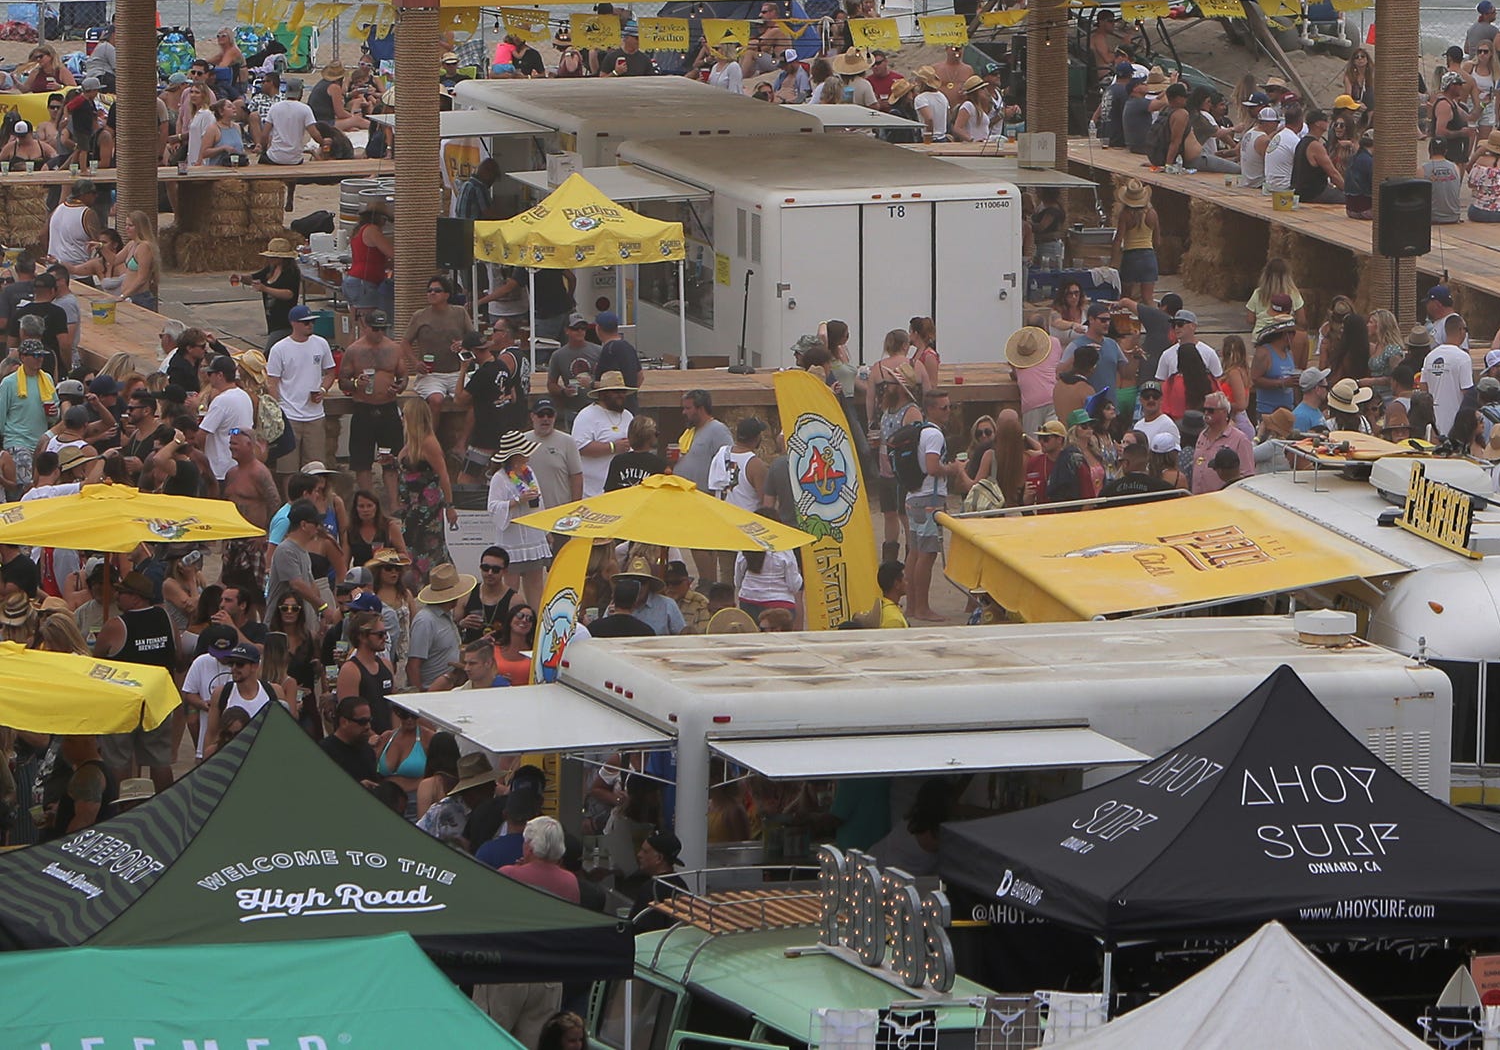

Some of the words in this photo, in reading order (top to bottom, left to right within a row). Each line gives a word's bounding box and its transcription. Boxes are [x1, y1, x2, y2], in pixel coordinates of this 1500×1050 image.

[887, 205, 905, 218] T8
[1402, 460, 1475, 549] PACIFICO
[1137, 753, 1224, 798] AHOY
[1241, 764, 1376, 805] AHOY
[1072, 800, 1158, 842] SURF
[61, 830, 165, 884] SAFEPORT
[1257, 823, 1399, 859] SURF
[197, 849, 336, 892] WELCOME
[346, 850, 387, 868] TO
[397, 857, 457, 886] THE
[1308, 861, 1363, 874] OXNARD,
[1364, 861, 1382, 872] CA
[235, 886, 333, 916] High
[334, 883, 433, 907] Road
[971, 904, 1049, 924] @AHOY
[1300, 899, 1435, 919] www.AHOYSURF.com
